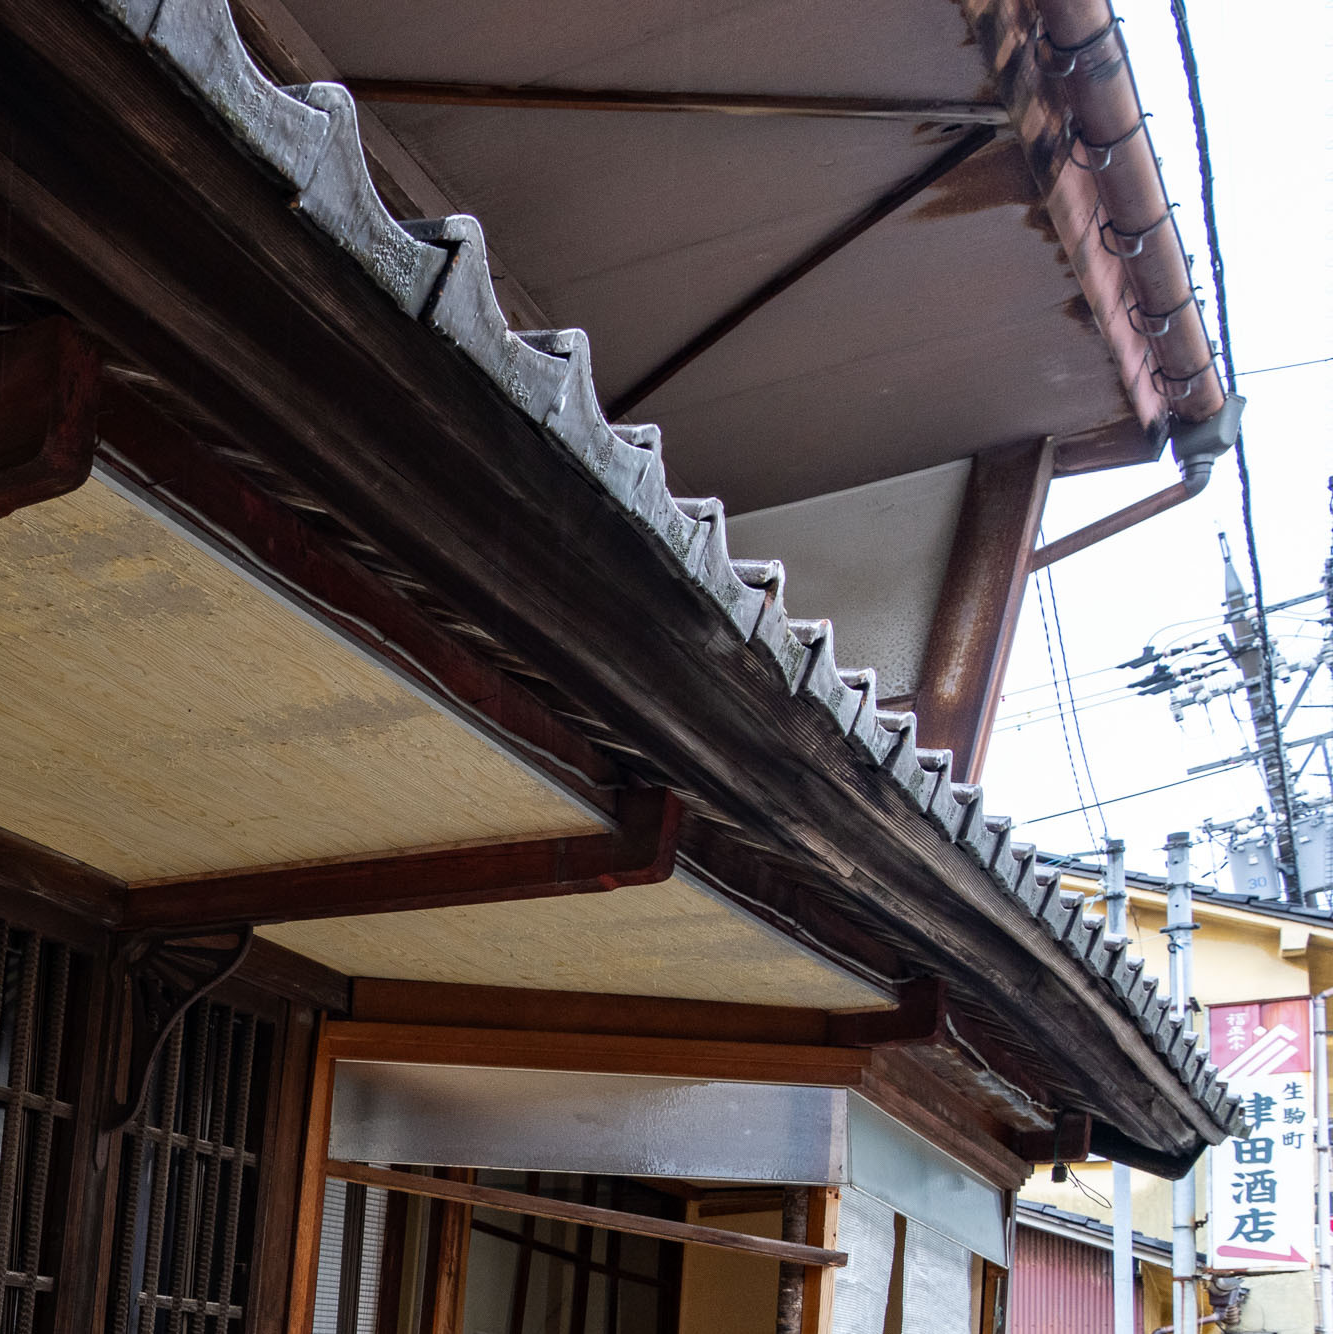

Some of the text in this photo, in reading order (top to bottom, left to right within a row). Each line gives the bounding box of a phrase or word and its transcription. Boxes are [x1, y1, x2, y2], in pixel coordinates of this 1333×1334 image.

[1247, 876, 1267, 890] 30
[1225, 1012, 1247, 1051] 福正宗
[1282, 1081, 1306, 1150] 生駒町
